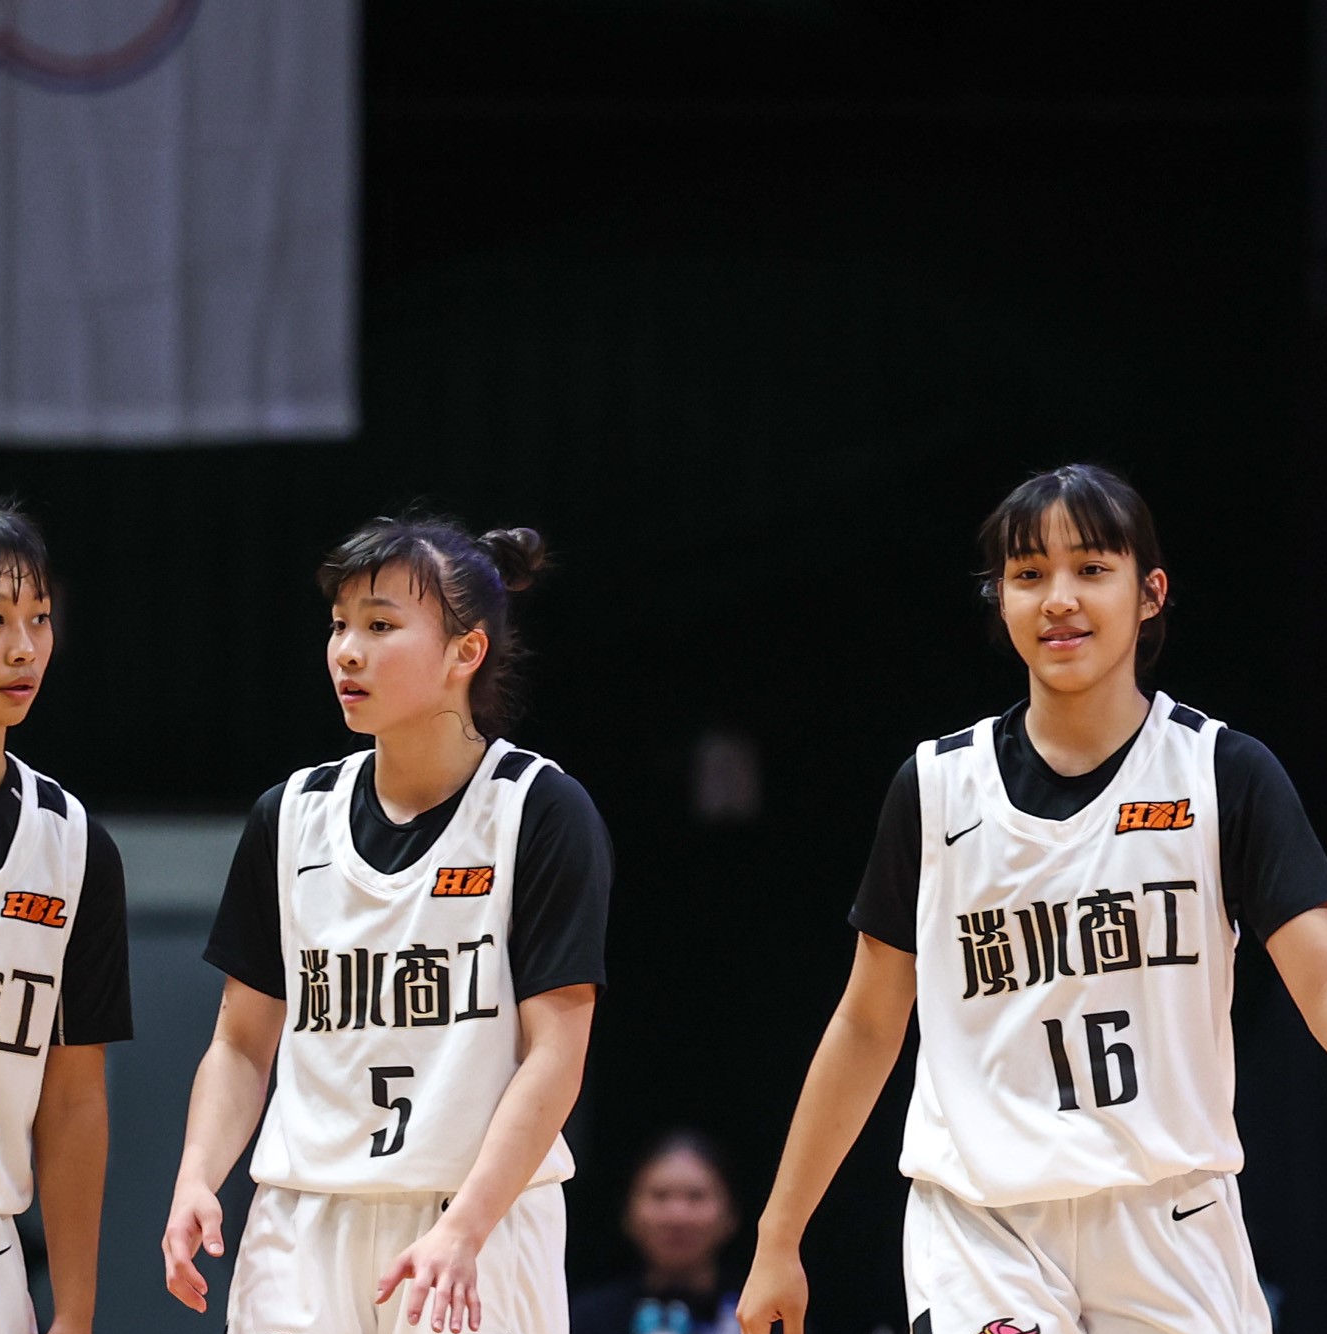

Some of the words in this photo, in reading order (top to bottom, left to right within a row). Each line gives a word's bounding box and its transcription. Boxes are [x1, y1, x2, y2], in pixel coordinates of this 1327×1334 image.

[1114, 798, 1195, 835] HBL
[1, 891, 67, 928] HBL
[431, 865, 496, 899] HB
[293, 934, 500, 1033] 淡水商工
[956, 880, 1200, 1000] 淡水商工
[1042, 1010, 1138, 1112] 16
[368, 1066, 415, 1158] 5
